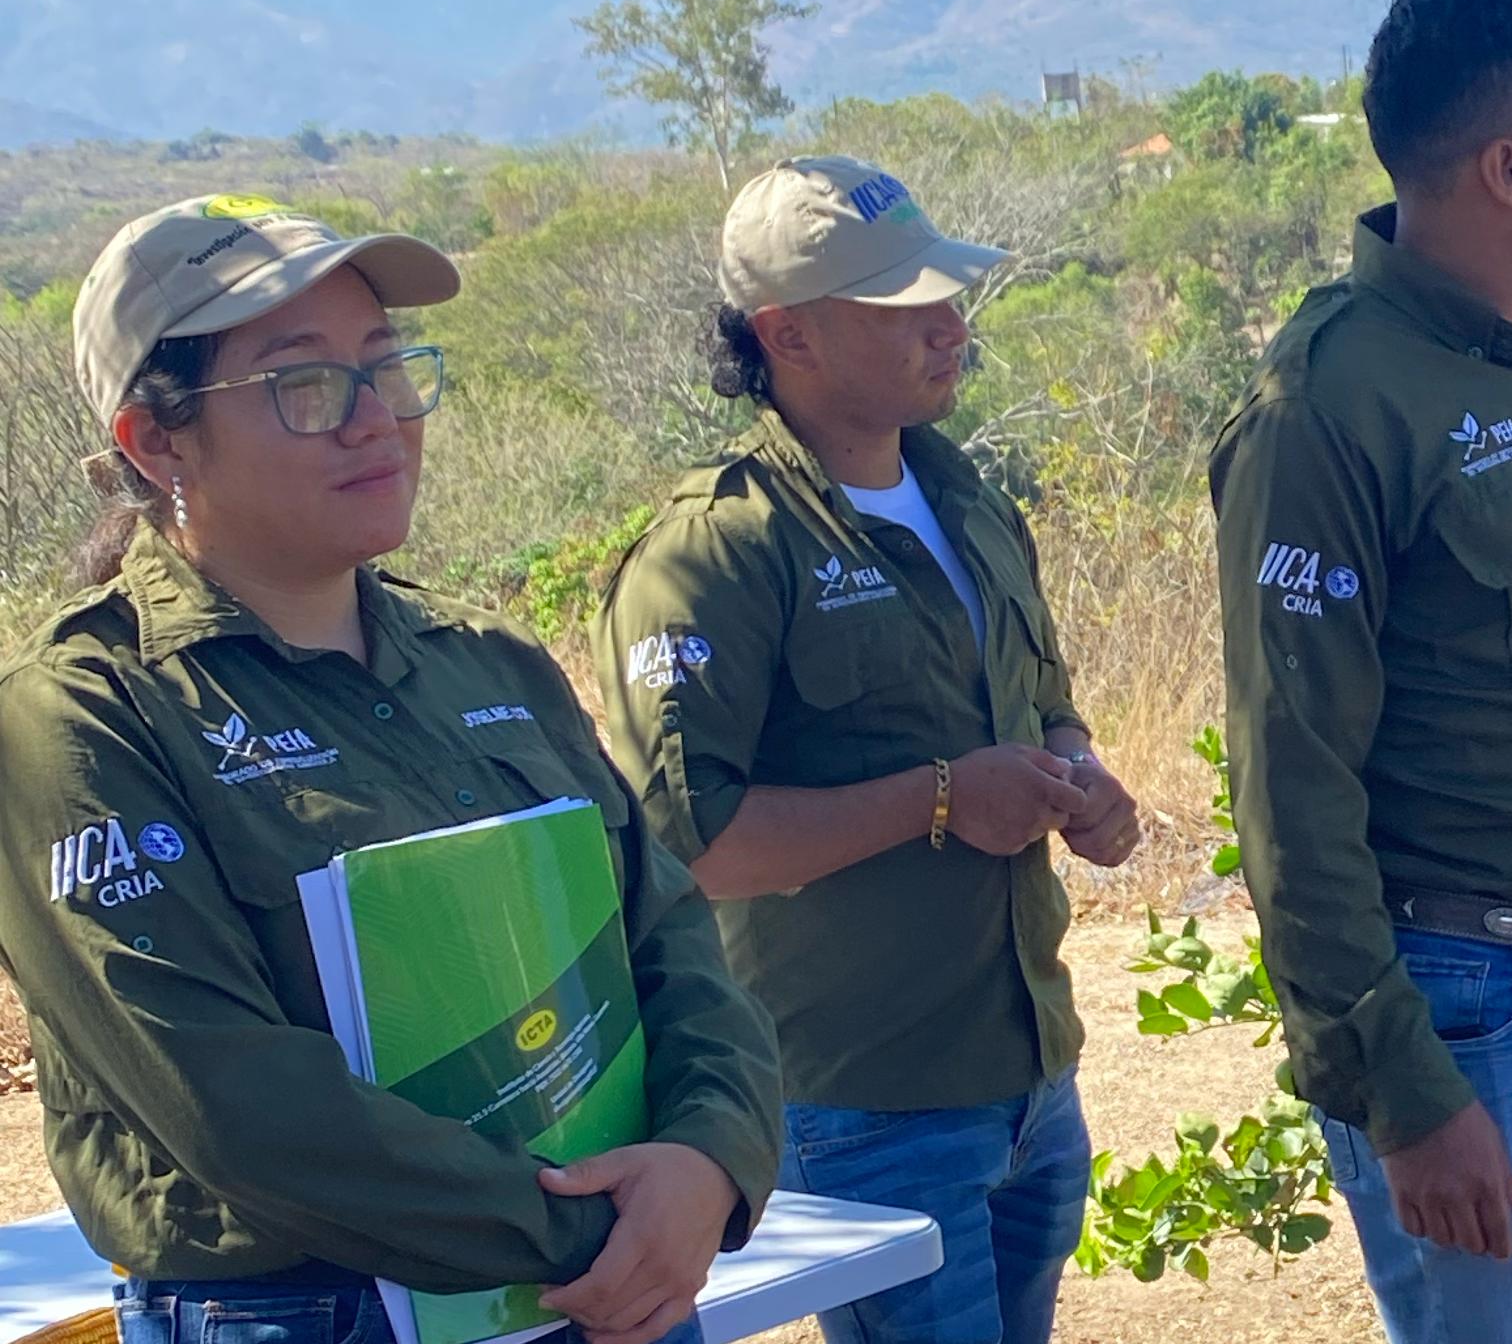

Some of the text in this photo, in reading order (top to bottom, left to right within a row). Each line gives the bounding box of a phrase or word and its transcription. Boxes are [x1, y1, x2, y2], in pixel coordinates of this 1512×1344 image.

[851, 566, 886, 588] PEIA
[1257, 542, 1320, 594] IICA
[1282, 594, 1322, 617] CRIA
[627, 632, 677, 684] IICA
[645, 667, 687, 688] CRIA
[262, 728, 317, 753] PEIA
[50, 819, 137, 902] IICA
[98, 870, 164, 907] CRIA
[520, 1014, 553, 1046] ICTA
